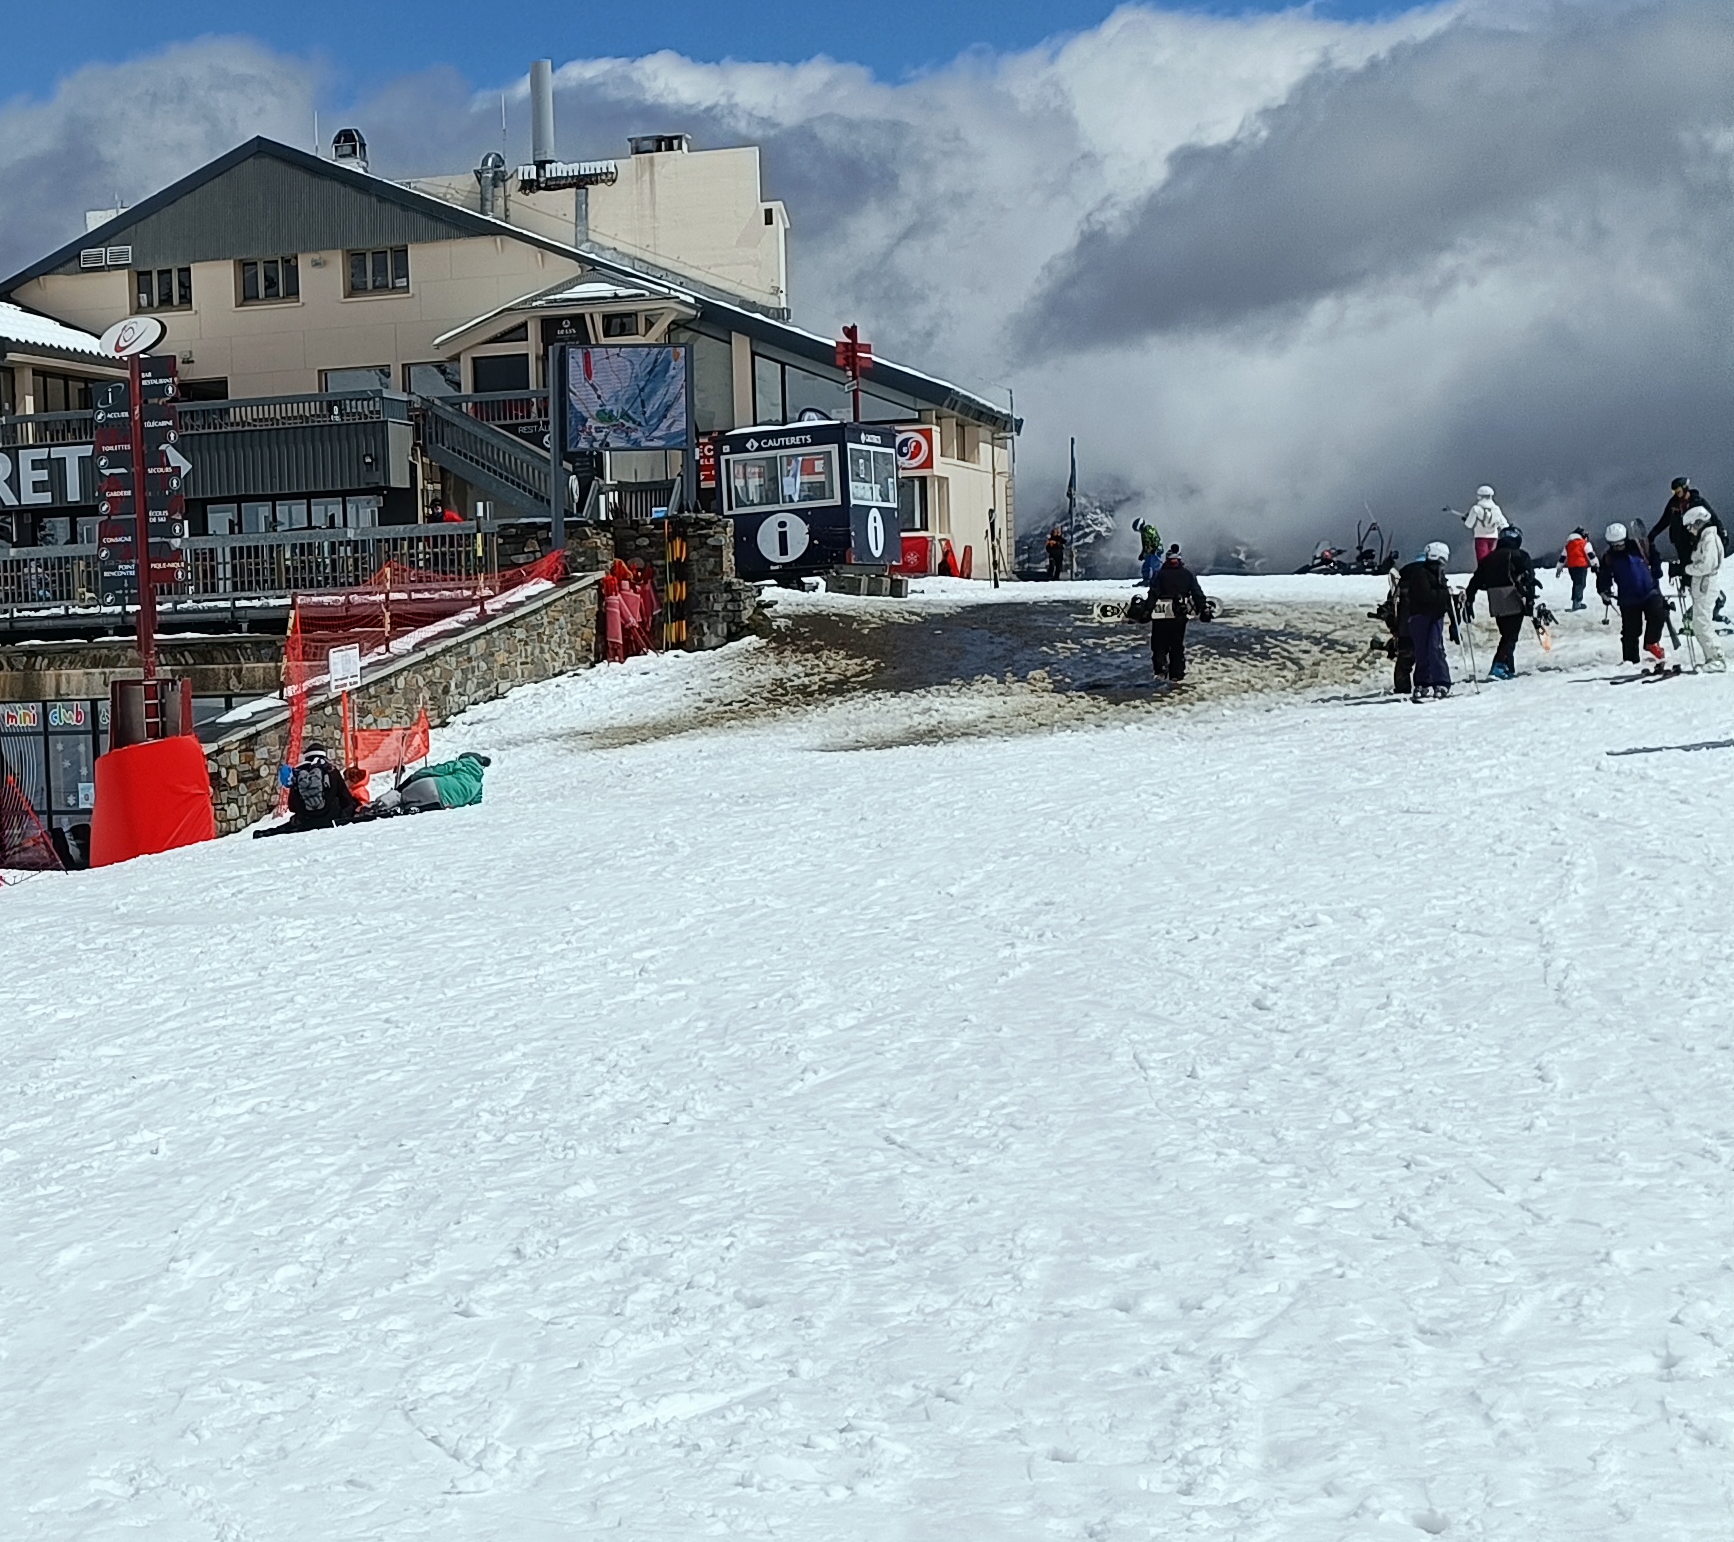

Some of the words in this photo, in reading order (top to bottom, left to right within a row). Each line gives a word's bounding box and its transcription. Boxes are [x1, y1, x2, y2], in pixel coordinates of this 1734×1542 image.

[106, 411, 129, 419] ACCUEIL
[143, 420, 174, 428] TÉLÉCABINE
[760, 434, 812, 448] CAUTERETS
[101, 444, 131, 452] TOILETTES
[147, 466, 173, 474] SECOURS
[105, 490, 132, 498] GARDERIE
[148, 509, 169, 517] ÉCOLES
[102, 536, 132, 544] CONSIGNE
[150, 561, 185, 569] PIQUE-NIQUE
[5, 703, 38, 727] mini
[48, 701, 85, 726] club
